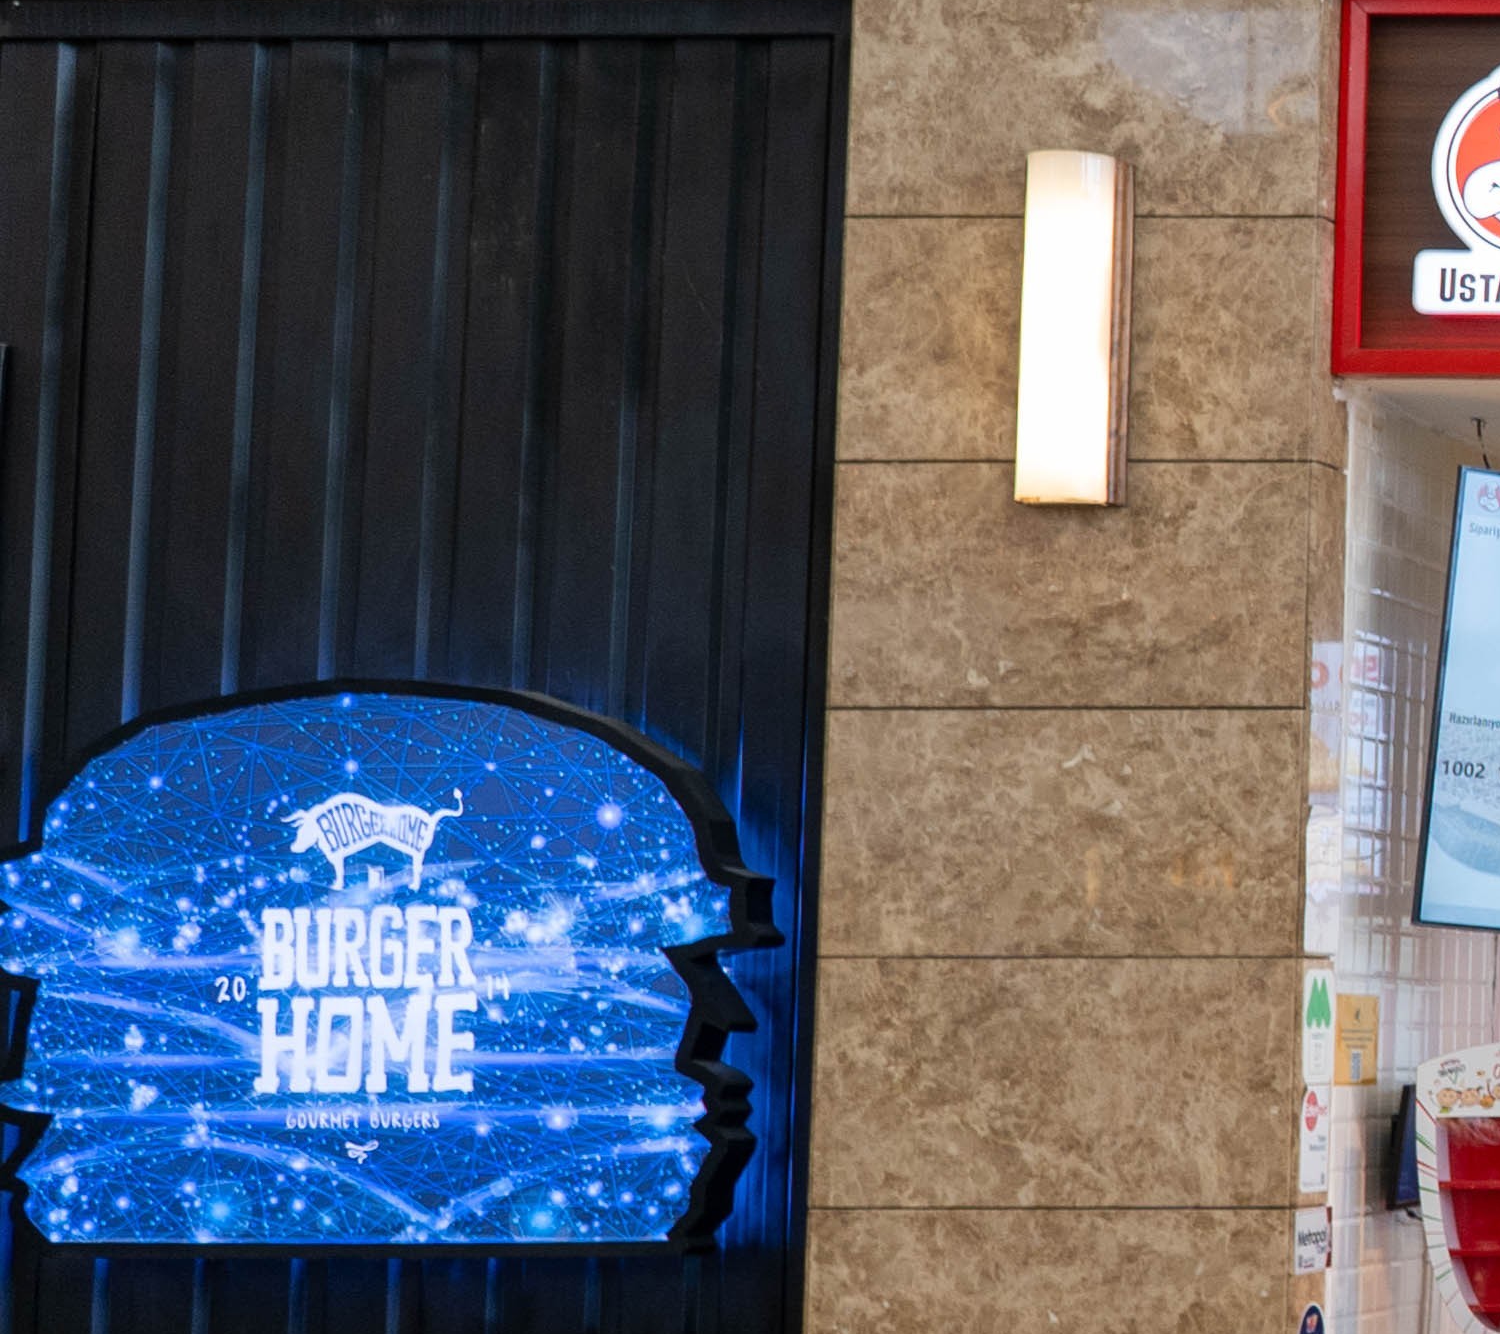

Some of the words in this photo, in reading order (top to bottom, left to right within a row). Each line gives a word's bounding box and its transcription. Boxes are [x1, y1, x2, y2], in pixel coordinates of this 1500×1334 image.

[1442, 760, 1486, 780] 1002
[259, 906, 478, 991] BURGER
[215, 976, 247, 1004] 20
[253, 991, 478, 1094] HOME
[286, 1111, 360, 1129] GOURMET
[369, 1111, 440, 1130] BURGERS
